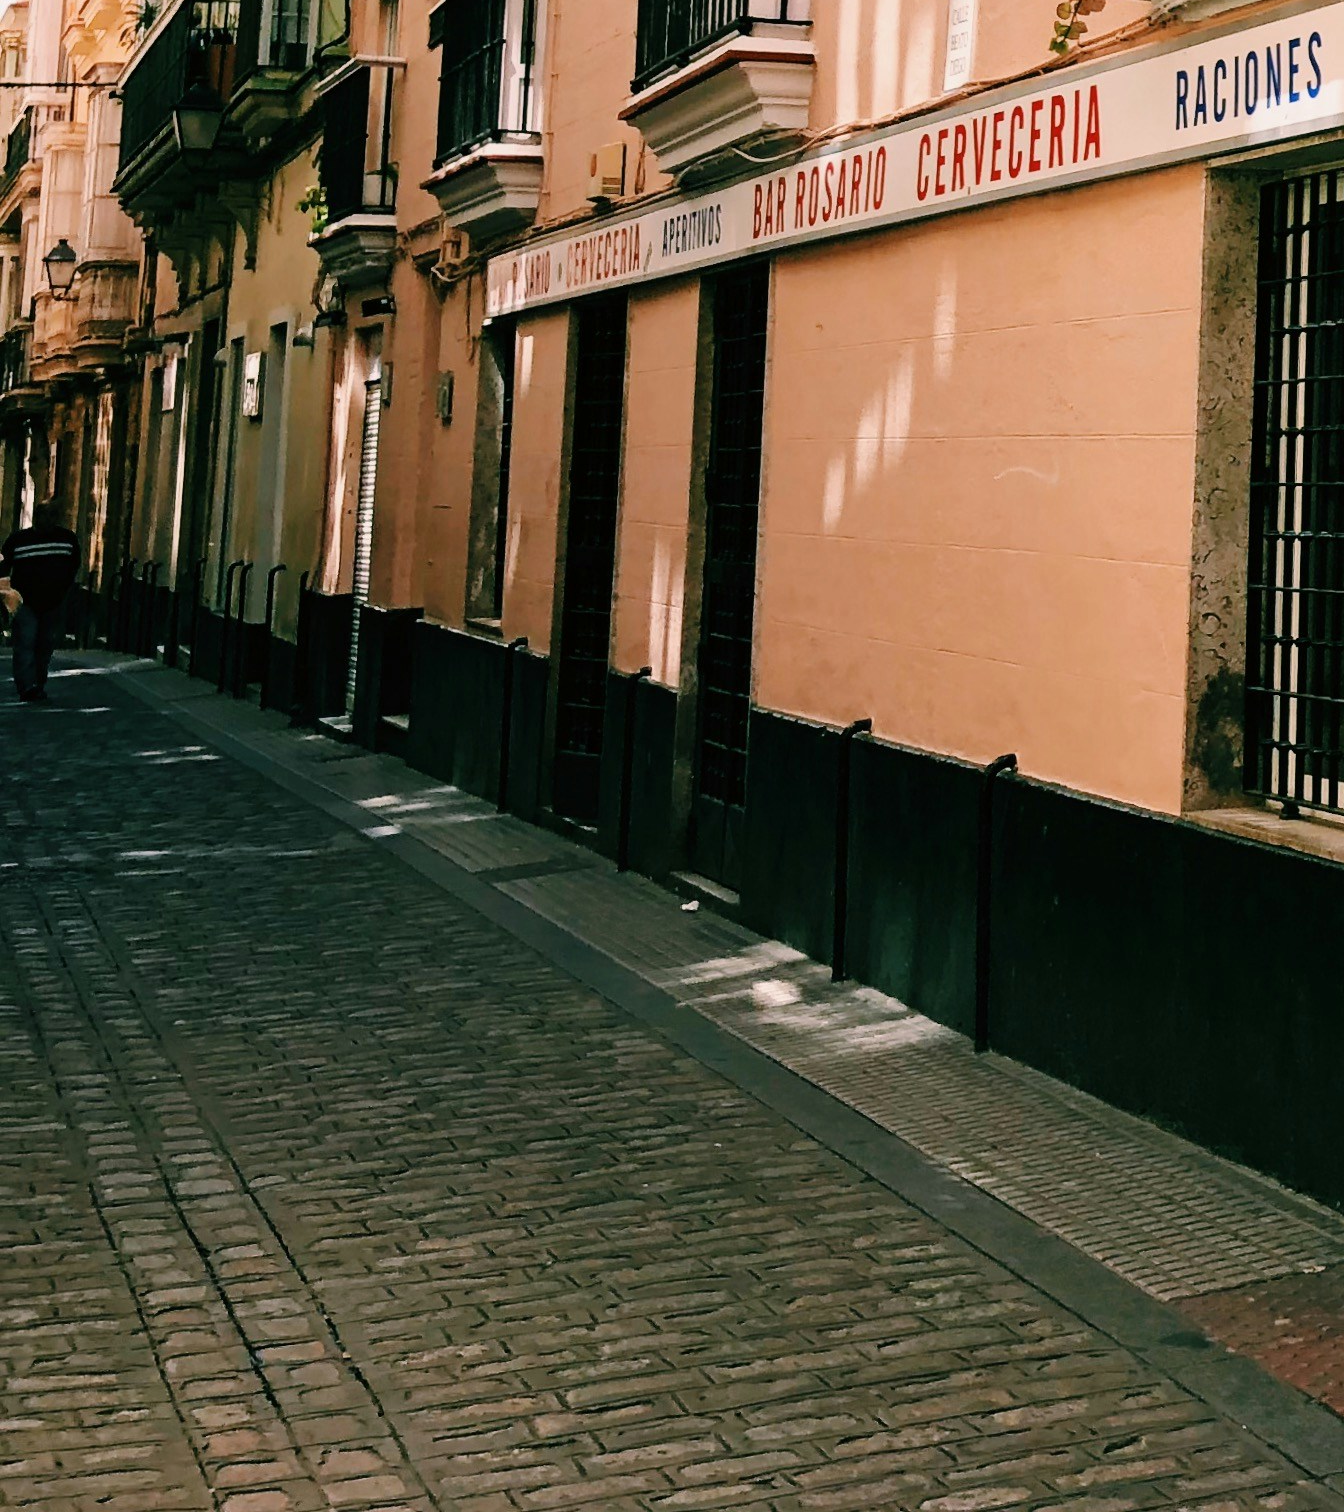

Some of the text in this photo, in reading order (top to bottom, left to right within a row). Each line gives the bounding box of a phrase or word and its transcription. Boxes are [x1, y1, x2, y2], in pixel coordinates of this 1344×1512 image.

[565, 222, 641, 289] CERVECERIA
[661, 203, 722, 258] APERITIVOS
[752, 181, 787, 240] BAR
[793, 146, 888, 229] ROSARIO
[915, 84, 1101, 202] CERVECERIA
[1174, 30, 1323, 131] RACIONES
